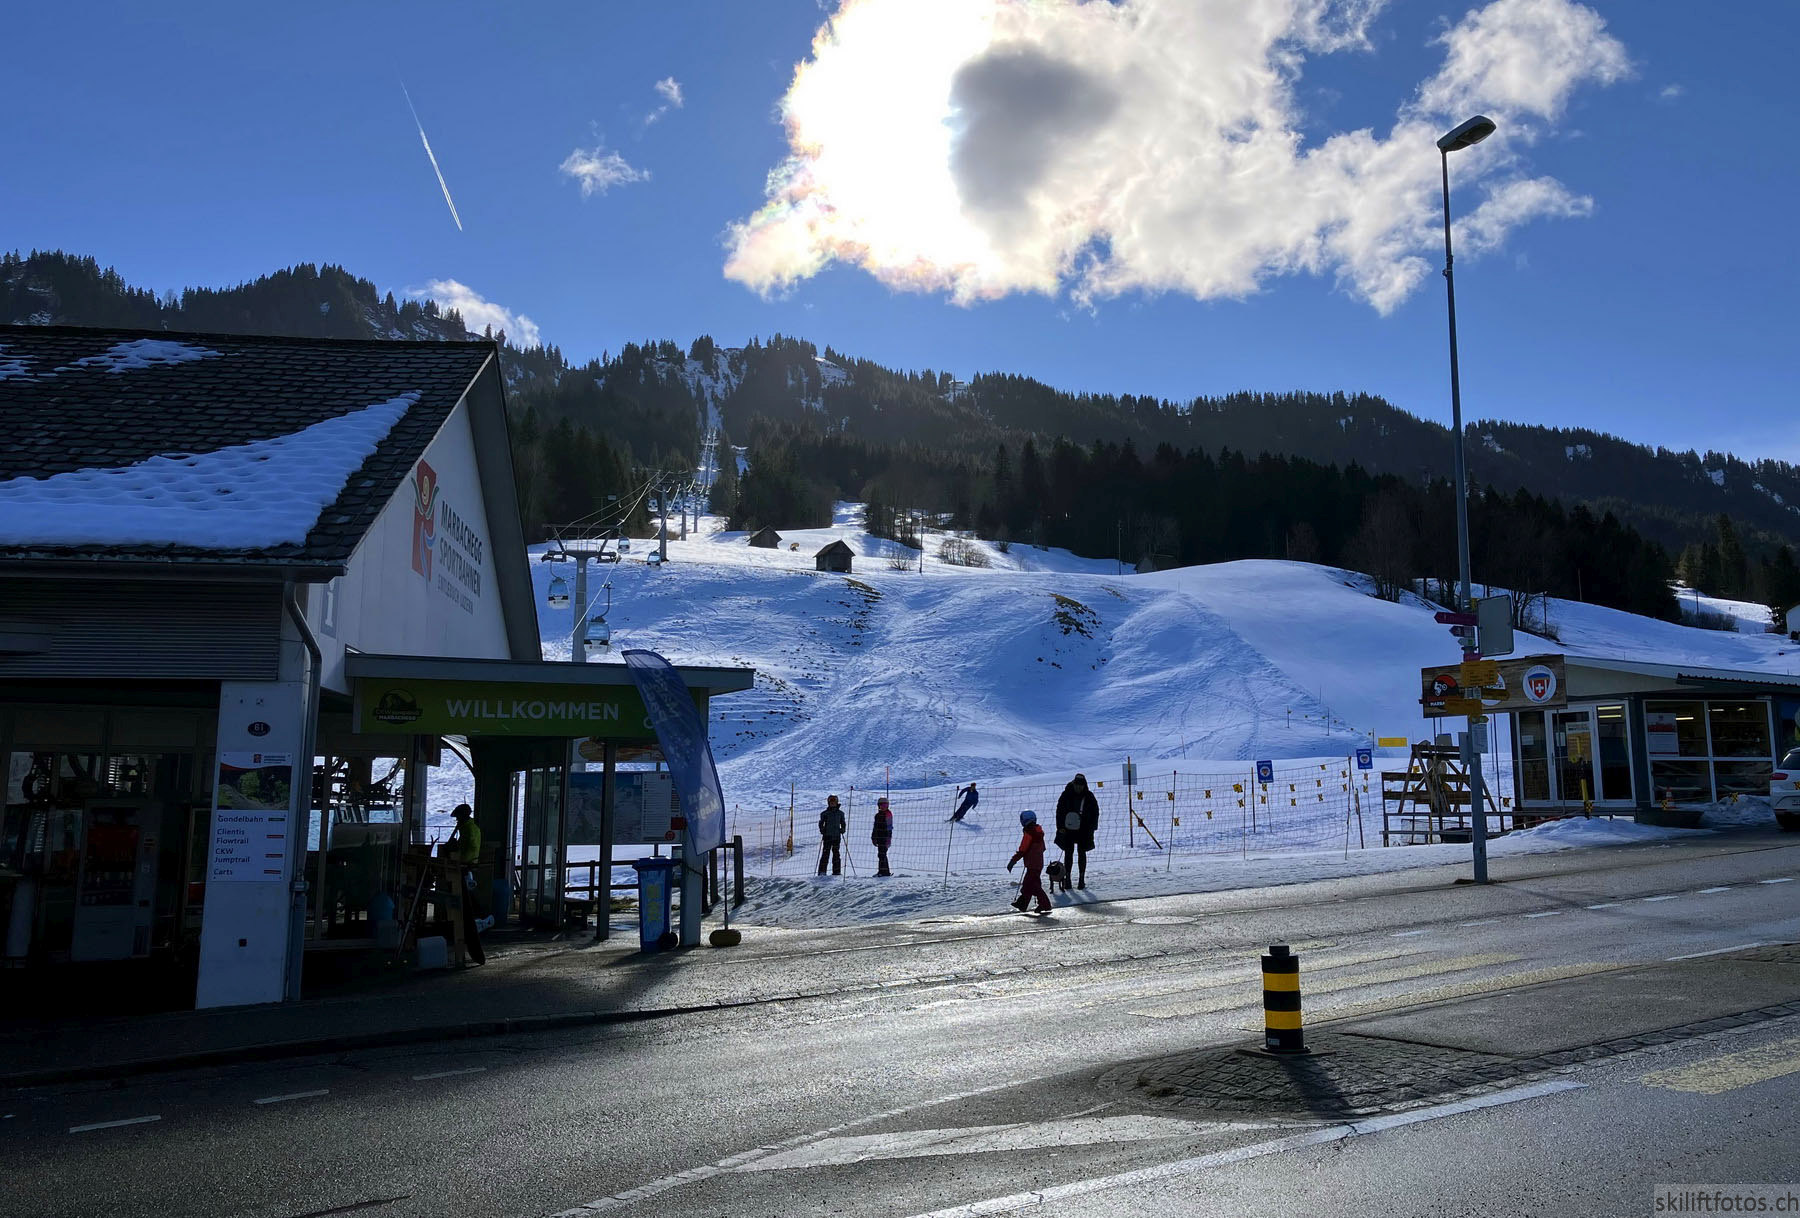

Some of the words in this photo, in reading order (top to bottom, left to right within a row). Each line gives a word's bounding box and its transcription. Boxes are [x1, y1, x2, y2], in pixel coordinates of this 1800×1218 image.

[441, 500, 482, 566] MARBACHEGG
[440, 537, 481, 598] SPORTBAHNEN
[446, 698, 619, 721] WILLKOMMEN
[217, 815, 264, 823] Gondelbahn
[217, 828, 245, 836] Clientis
[216, 837, 249, 845] Flowtrail
[215, 847, 234, 855] CKW
[214, 856, 250, 864] Jumptrail
[213, 868, 233, 876] Carts
